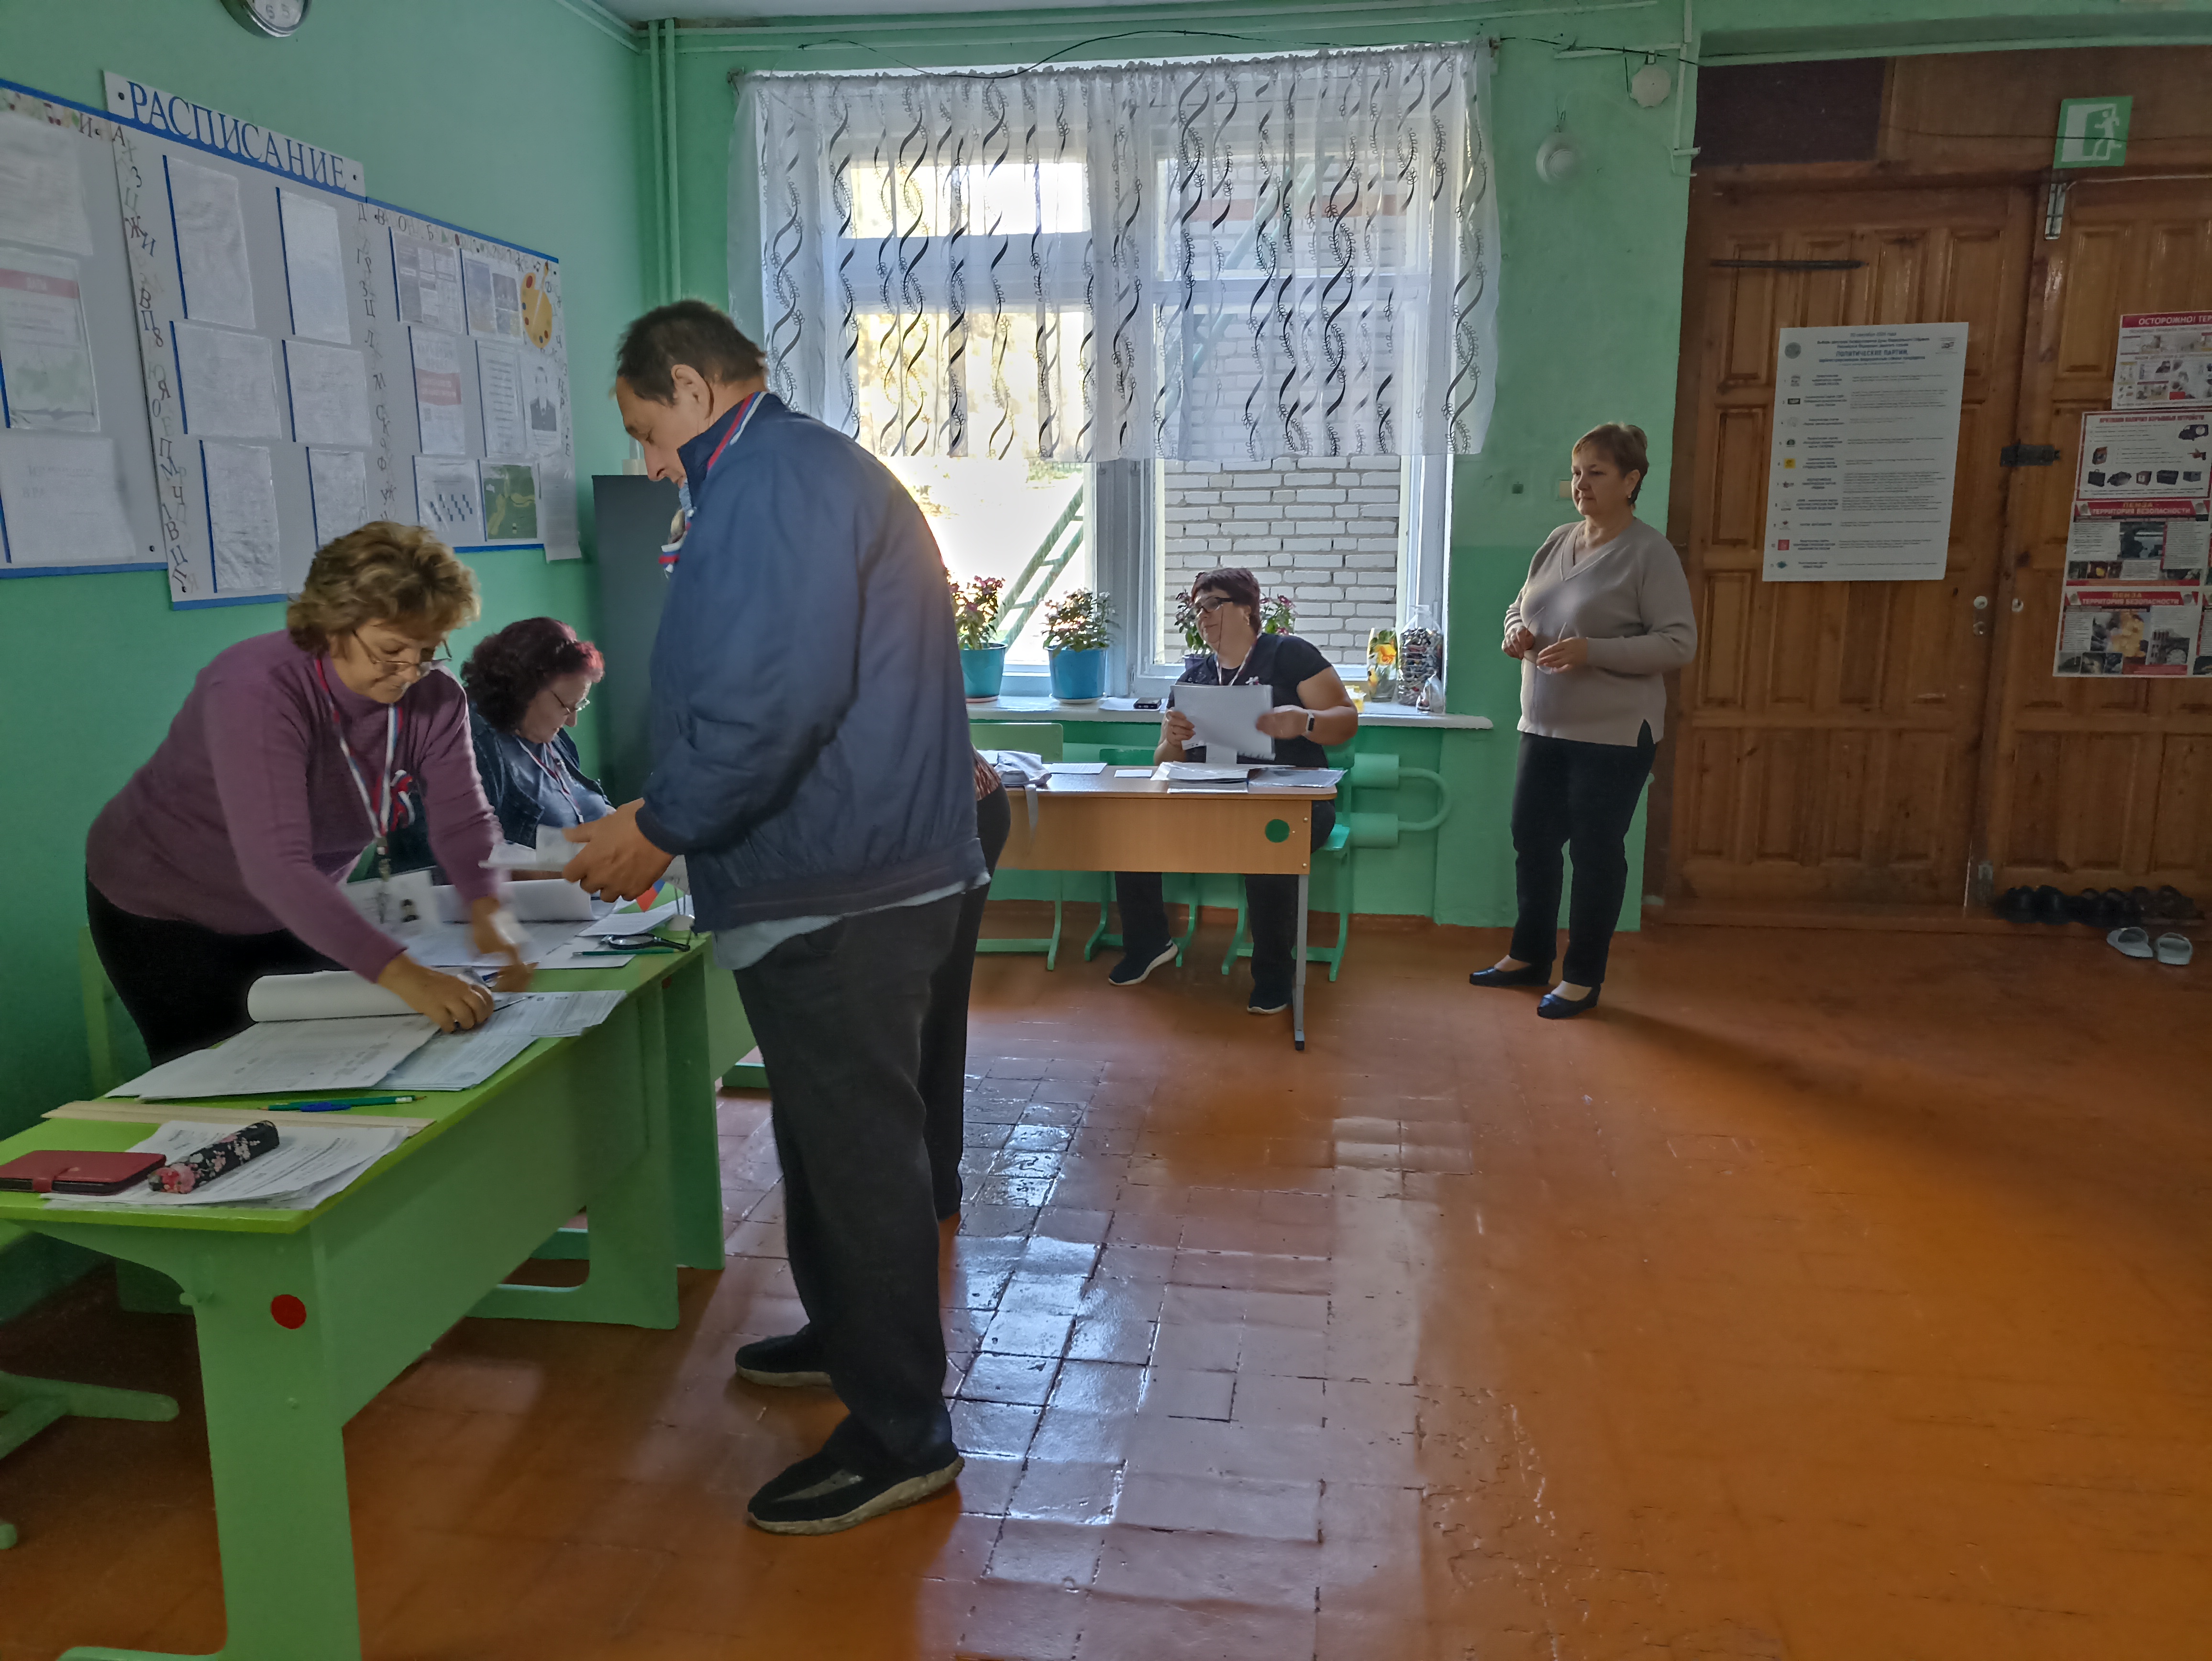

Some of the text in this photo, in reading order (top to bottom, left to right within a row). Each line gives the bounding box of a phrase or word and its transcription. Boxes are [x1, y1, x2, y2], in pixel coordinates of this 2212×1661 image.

[265, 4, 275, 19] 6
[127, 80, 346, 191] РАСПИСАНИЕ
[139, 288, 151, 310] В
[2139, 316, 2196, 325] ОСТОРОЖНО!
[158, 380, 171, 400] Я
[166, 521, 179, 541] В
